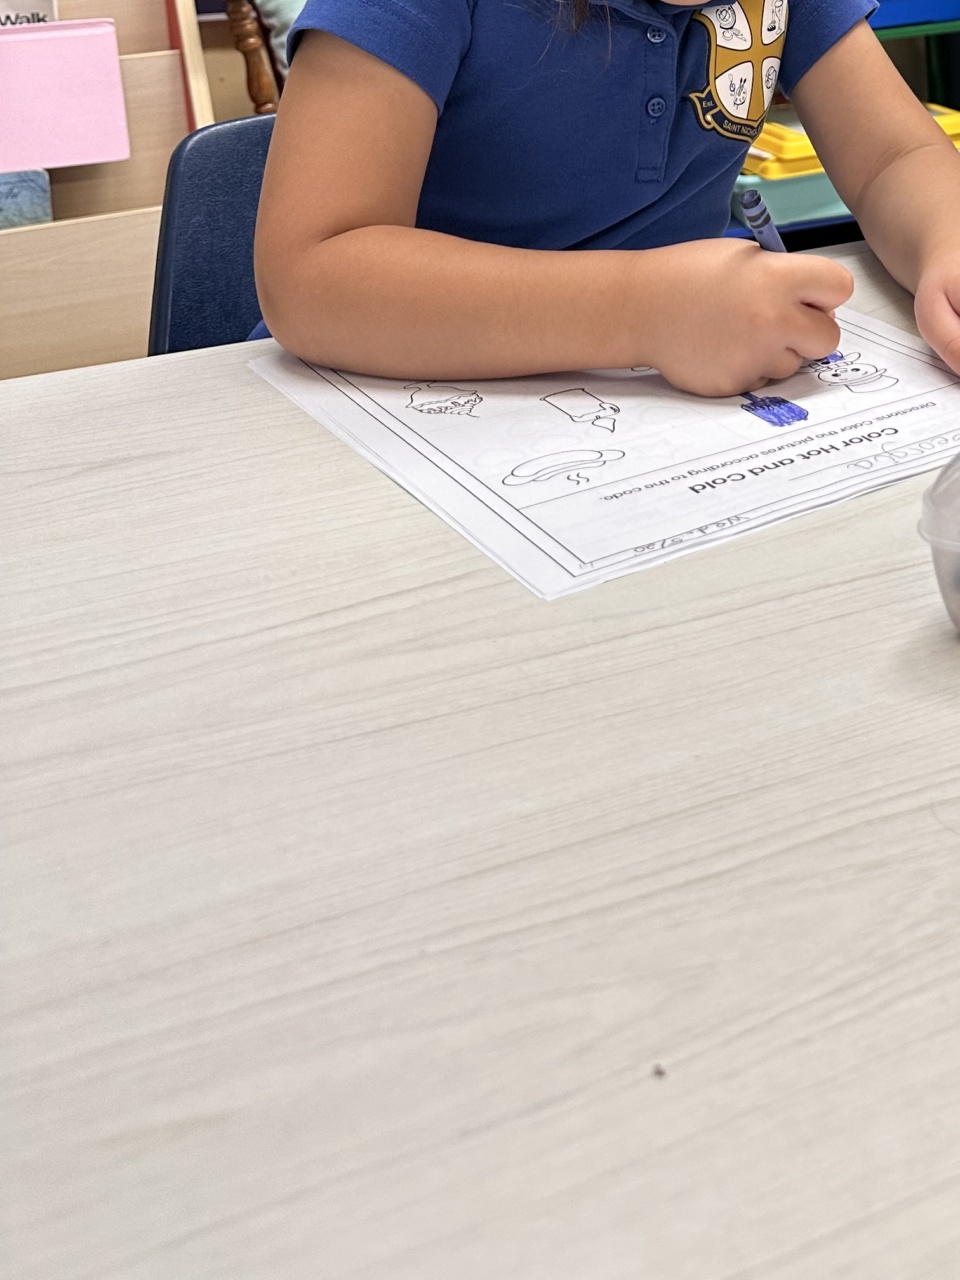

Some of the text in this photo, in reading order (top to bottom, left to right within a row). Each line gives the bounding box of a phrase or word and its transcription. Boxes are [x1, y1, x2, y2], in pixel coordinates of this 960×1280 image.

[875, 401, 937, 422] Directions:
[815, 429, 839, 439] the
[839, 419, 873, 432] Color
[760, 435, 815, 456] pictures
[688, 426, 899, 495] Color Hot and Cold
[688, 452, 759, 477] according
[644, 478, 670, 489] the
[600, 487, 642, 501] code.
